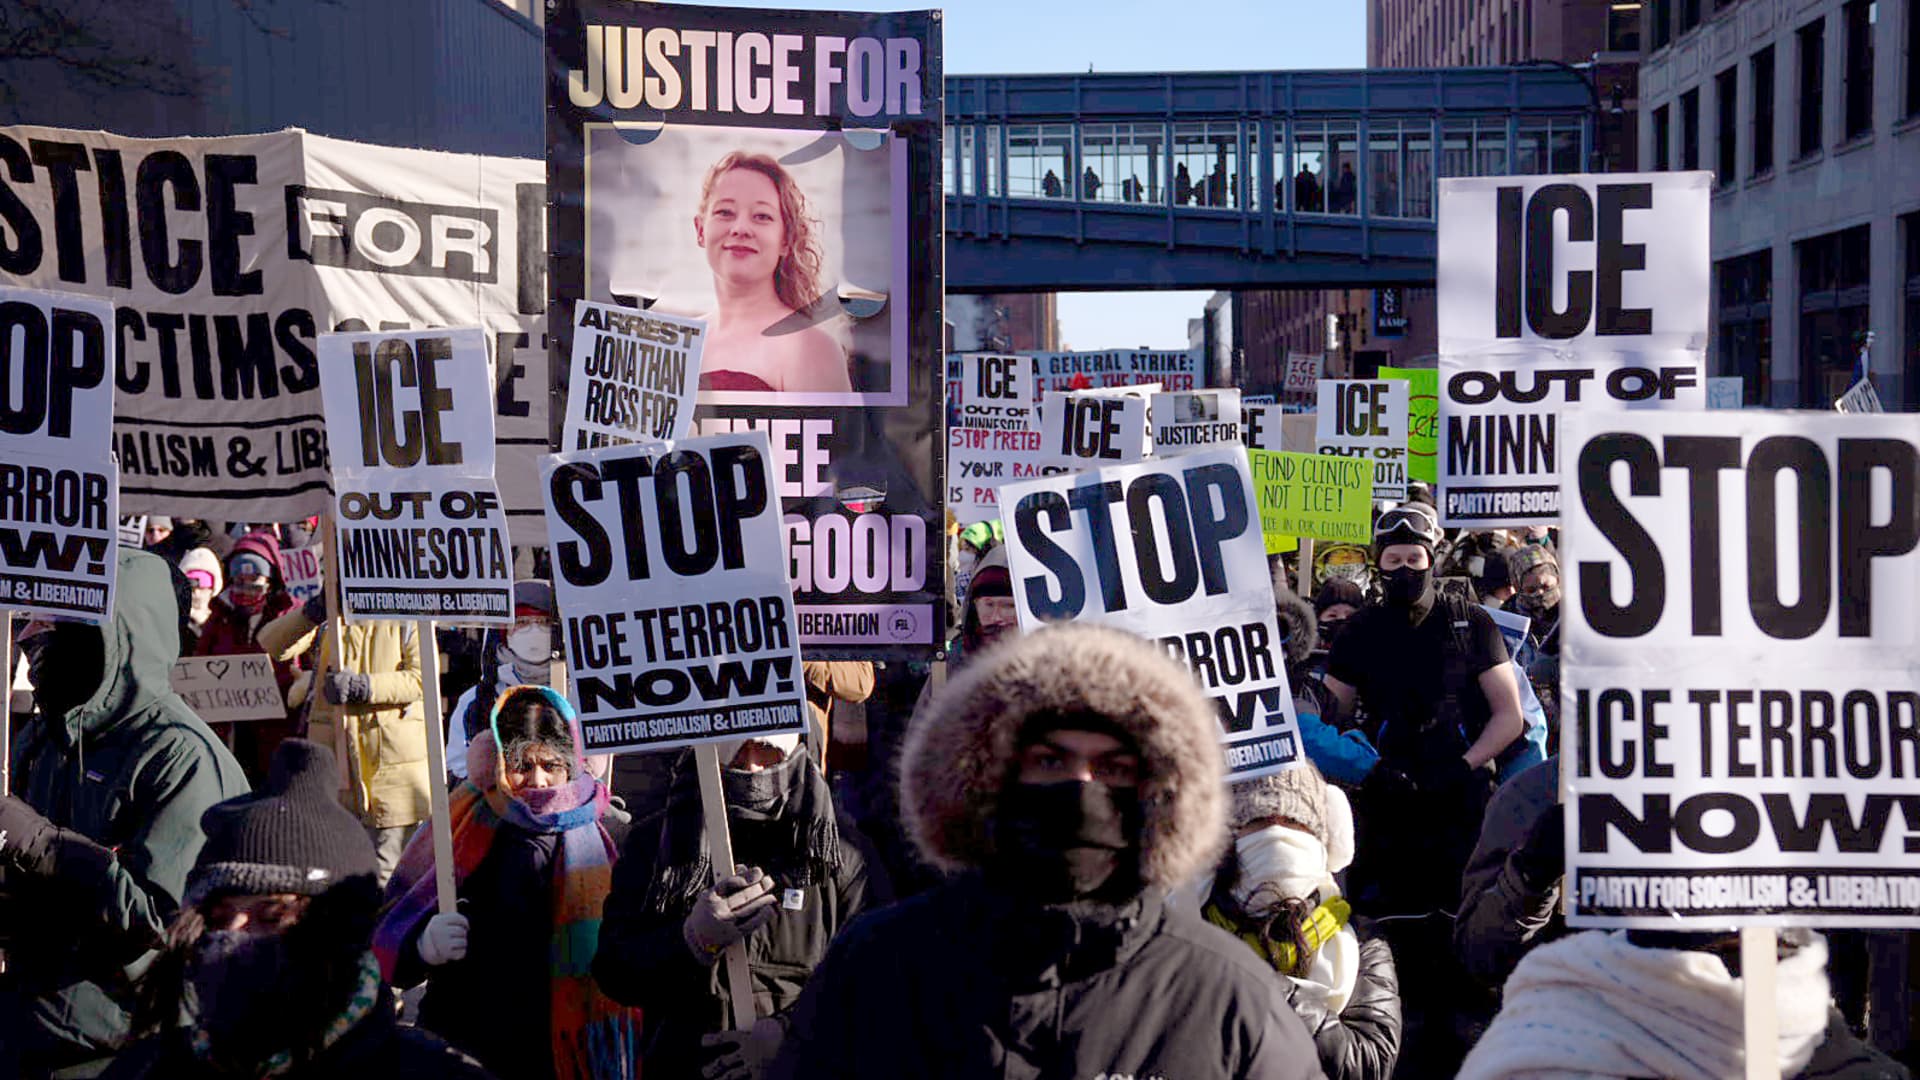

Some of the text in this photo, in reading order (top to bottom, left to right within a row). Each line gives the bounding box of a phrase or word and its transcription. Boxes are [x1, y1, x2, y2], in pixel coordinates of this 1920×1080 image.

[568, 25, 922, 117] JUSTICE FOR
[305, 200, 491, 274] FOR
[1496, 183, 1653, 339] ICE
[579, 307, 700, 349] ARREST
[0, 301, 105, 438] OP
[114, 306, 320, 400] CTIMS
[584, 334, 687, 397] JONATHAN
[1050, 353, 1121, 375] GENERAL
[1130, 353, 1194, 374] STRIKE:
[1291, 361, 1316, 374] ICE
[977, 357, 1018, 399] ICE
[1448, 369, 1594, 404] OUT
[1606, 367, 1697, 400] OF
[352, 337, 462, 468] ICE
[584, 379, 678, 439] ROSS FOR
[965, 405, 1030, 417] OUT OF
[1336, 383, 1389, 436] ICE
[951, 429, 989, 450] STOP
[1062, 397, 1124, 460] ICE
[1157, 423, 1237, 445] JUSTICE FOR
[1447, 414, 1555, 475] MINN
[226, 436, 268, 478] &
[960, 461, 1003, 478] YOUR
[1254, 454, 1363, 489] FUND CLINICS
[1319, 446, 1405, 459] OUT OF
[340, 491, 498, 520] OUT OF
[950, 486, 963, 503] IS
[1263, 485, 1343, 512] NOT ICE!
[1448, 493, 1493, 514] PARTY
[1494, 492, 1521, 513] FOR
[551, 445, 767, 587] STOP
[1578, 432, 1920, 640] STOP
[341, 527, 508, 579] MINNESOTA
[784, 513, 927, 593] GOOD
[1015, 463, 1249, 625] STOP
[281, 550, 317, 581] ND
[14, 581, 31, 601] &
[33, 582, 105, 609] LIBERATION
[348, 592, 507, 611] PARTY FOR SOCIALISM & LIBERATION
[569, 596, 790, 671] ICE TERROR
[241, 660, 267, 678] MY
[576, 656, 795, 714] NOW!
[585, 704, 799, 744] PARTY FOR SOCIALISM & LIBERATION
[1577, 688, 1920, 779] ICE TERROR
[1581, 876, 1648, 909] PARTY
[1651, 876, 1689, 909] FOR
[1690, 875, 1787, 908] SOCIALISM
[1788, 877, 1817, 907] &
